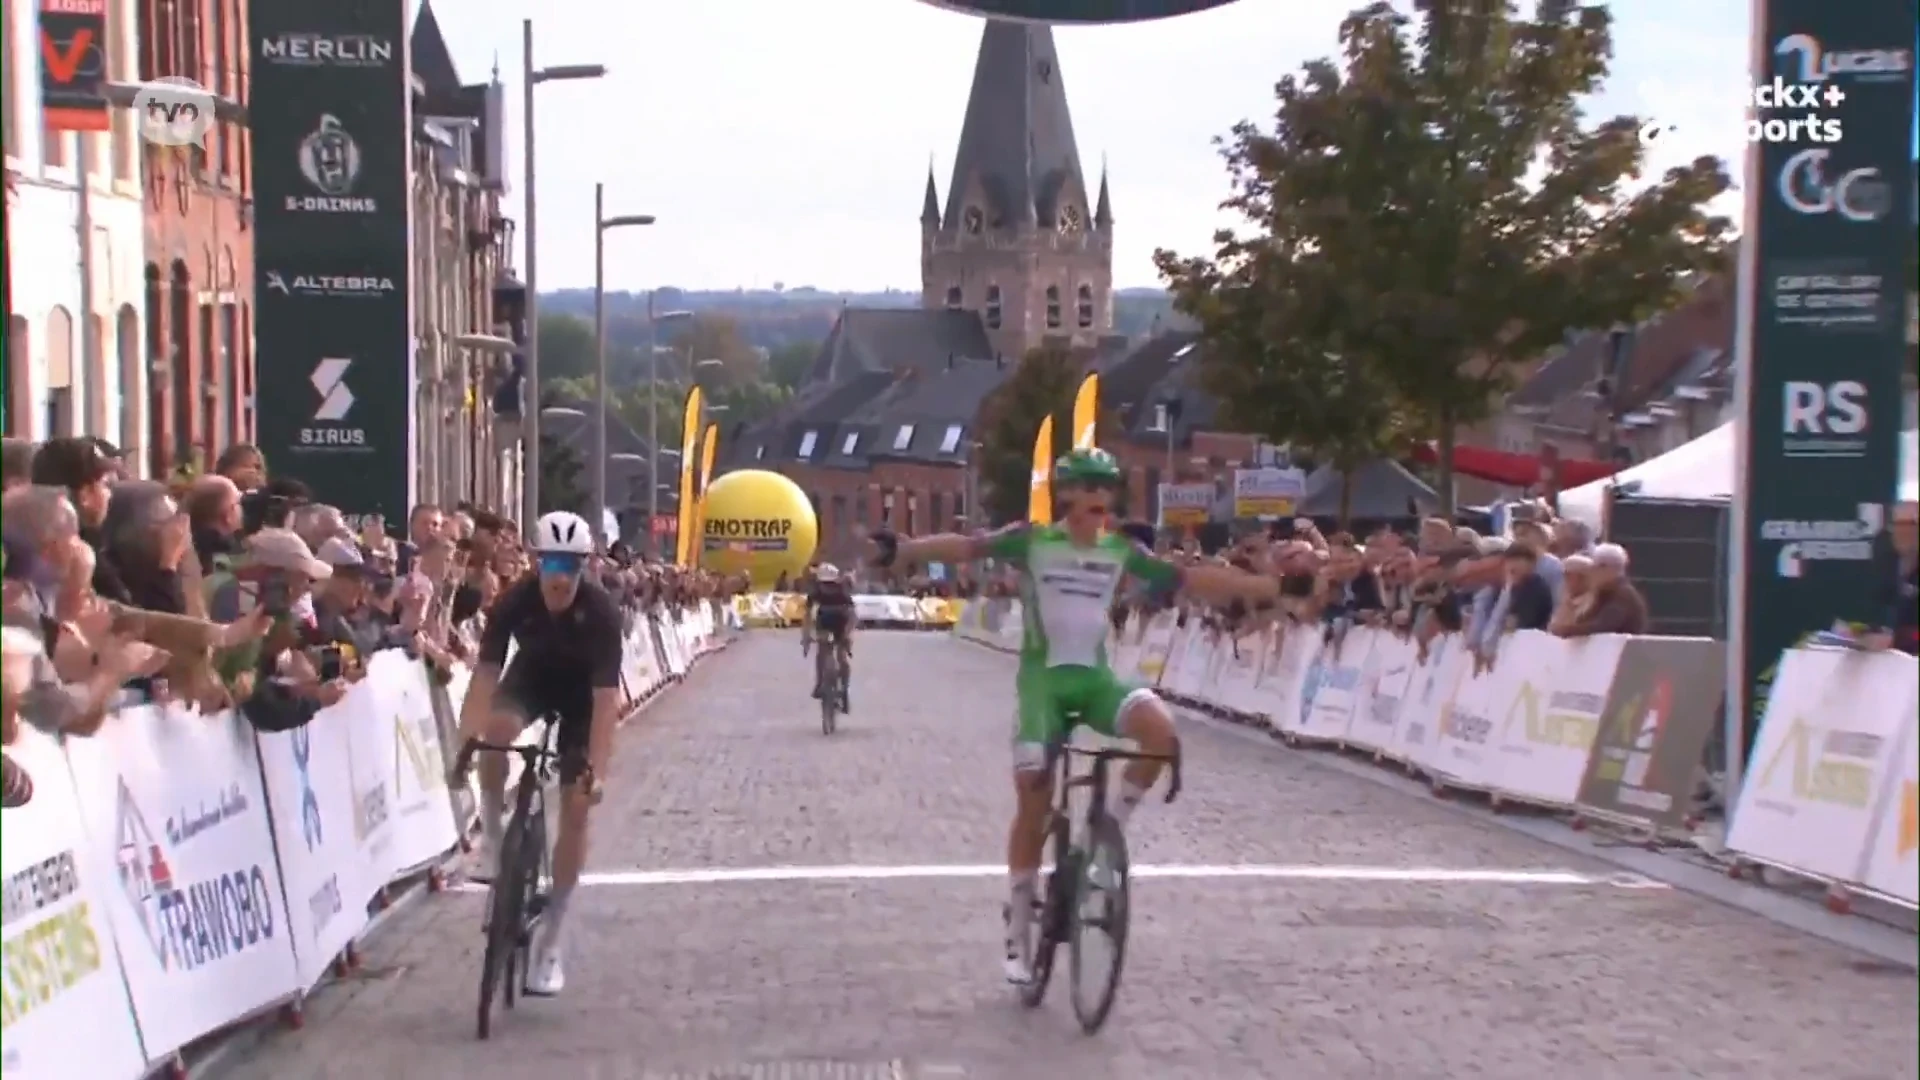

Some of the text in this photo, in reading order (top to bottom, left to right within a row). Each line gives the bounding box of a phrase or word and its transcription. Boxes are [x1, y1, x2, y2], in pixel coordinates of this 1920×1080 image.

[262, 38, 392, 60] MERLIN
[293, 275, 394, 291] ALTEBRA
[1783, 381, 1868, 433] RS
[301, 428, 365, 445] SIRUS
[160, 864, 273, 970] TRAWOBO
